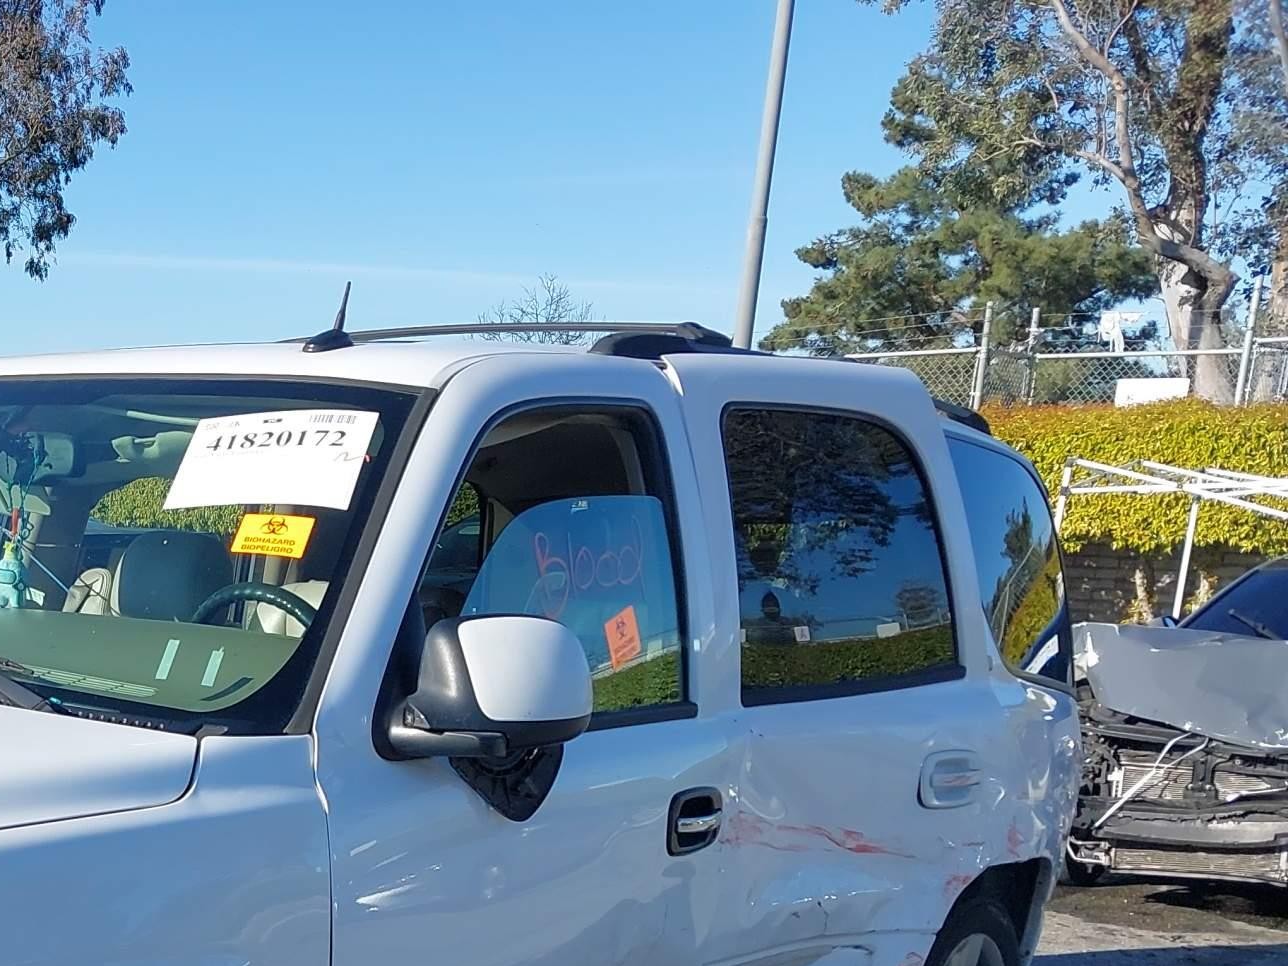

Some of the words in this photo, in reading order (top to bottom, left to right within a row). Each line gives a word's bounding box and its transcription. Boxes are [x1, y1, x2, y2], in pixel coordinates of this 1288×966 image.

[206, 430, 347, 451] 41820172
[244, 536, 296, 547] BIOHAZARD
[241, 544, 294, 555] BIOPELIGRO
